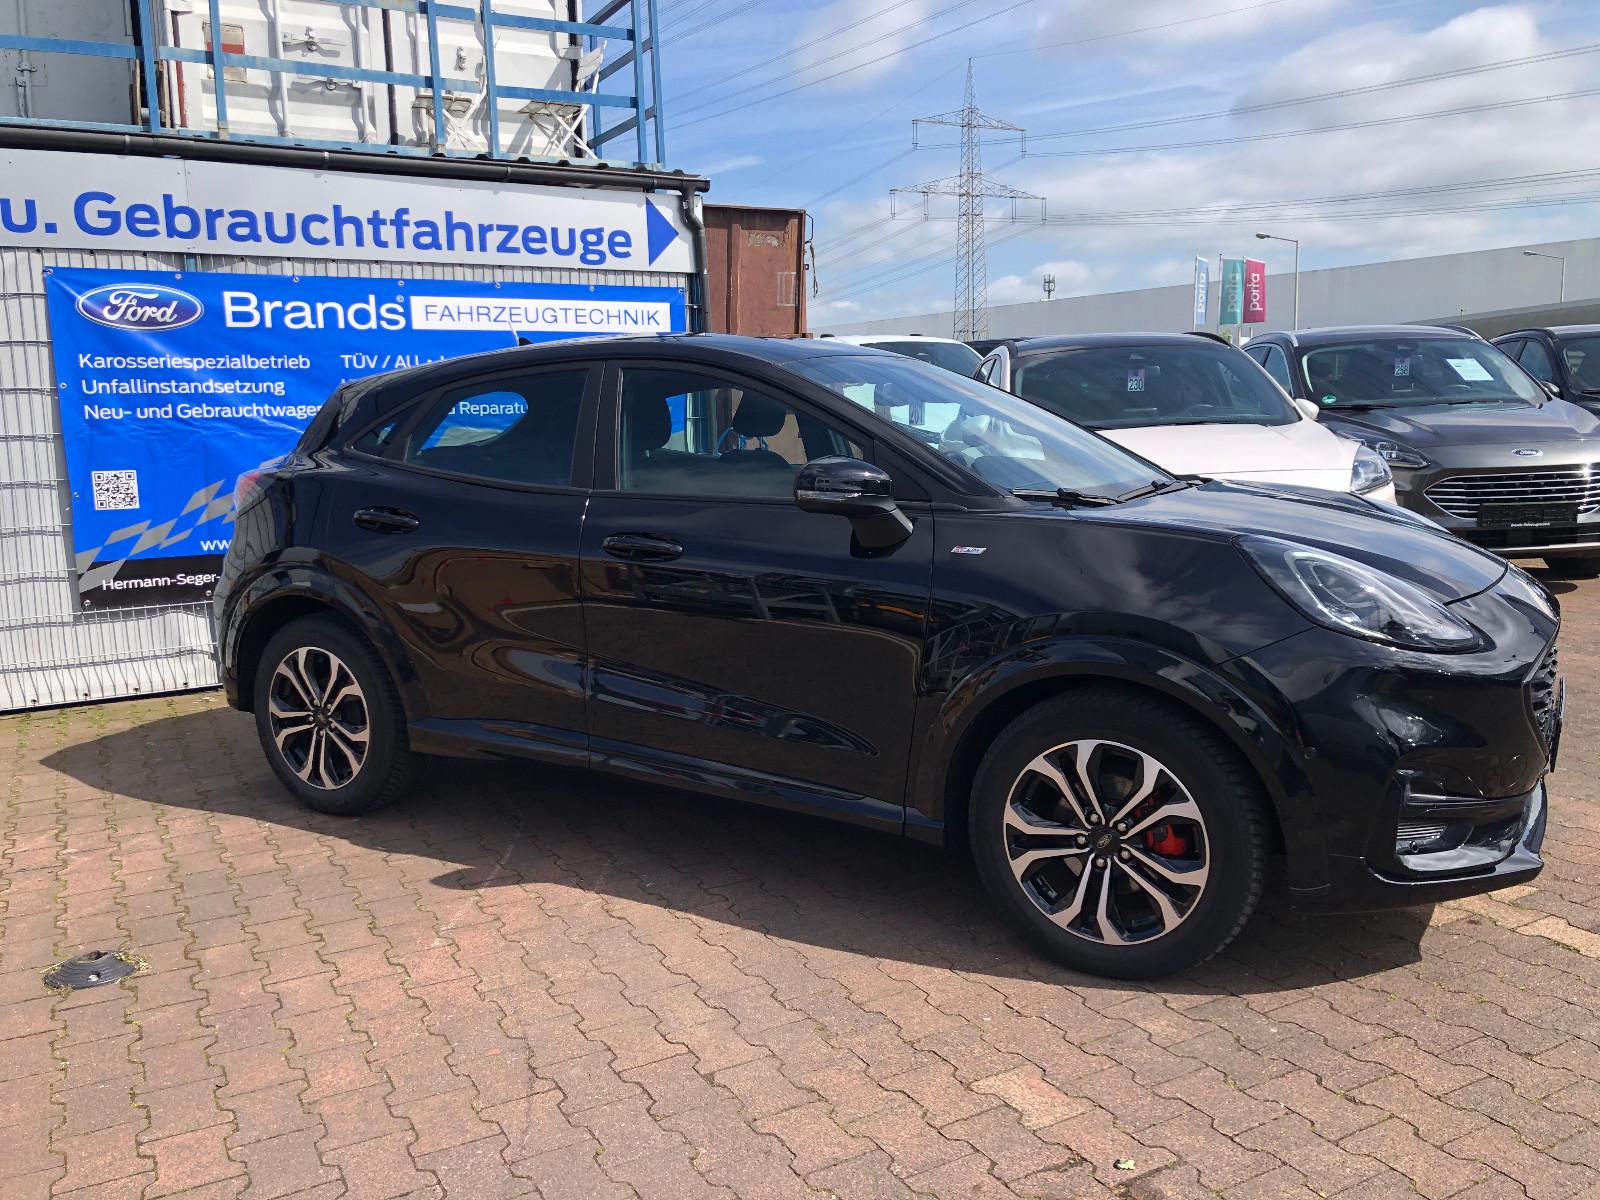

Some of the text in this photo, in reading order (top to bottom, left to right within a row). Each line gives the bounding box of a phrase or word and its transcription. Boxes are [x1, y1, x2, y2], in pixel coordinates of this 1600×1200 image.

[0, 191, 632, 265] u. Gebrauchtfahrzeuge
[1225, 272, 1240, 312] porta
[1247, 272, 1263, 311] porta
[102, 289, 178, 323] Ford
[223, 291, 660, 330] Brands FAHRZEUGTECHNIK
[79, 353, 310, 371] Karosseriespezialbetrieb
[340, 352, 378, 368] TÜV
[81, 378, 285, 396] Unfallinstandsetzung
[84, 403, 131, 419] Neu-
[136, 404, 172, 418] und
[102, 573, 221, 591] Hermann-Seger-
